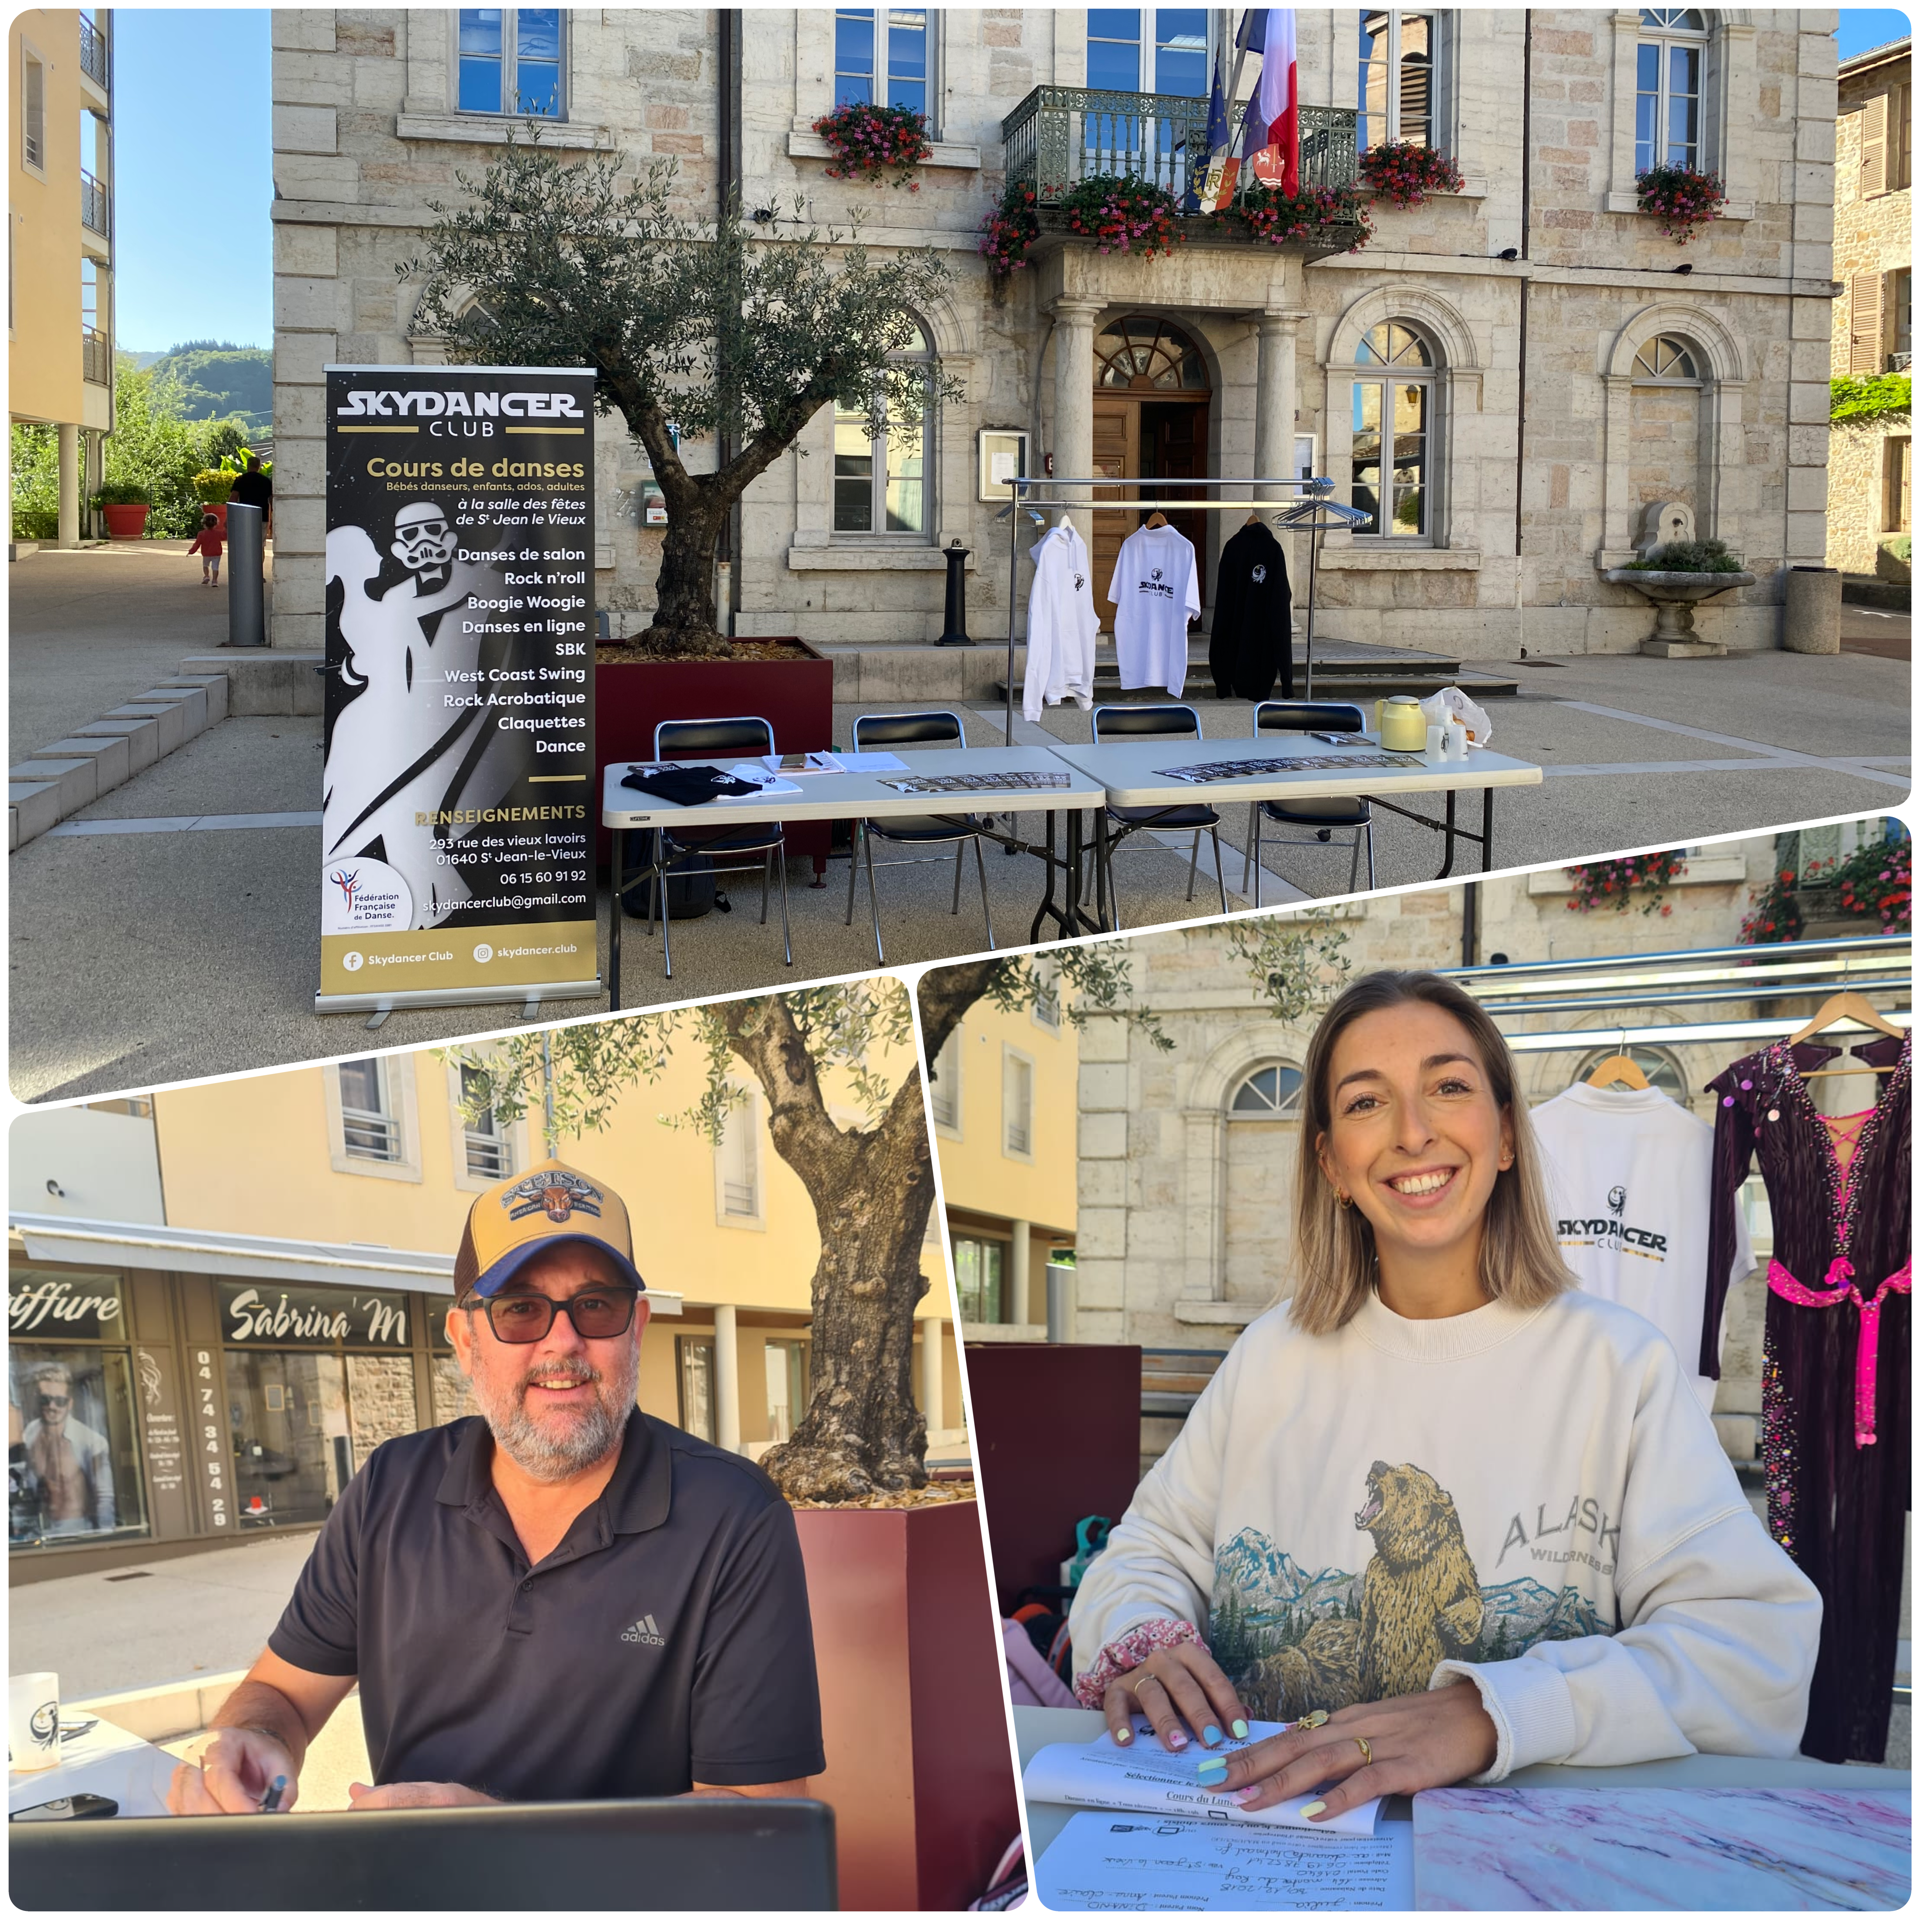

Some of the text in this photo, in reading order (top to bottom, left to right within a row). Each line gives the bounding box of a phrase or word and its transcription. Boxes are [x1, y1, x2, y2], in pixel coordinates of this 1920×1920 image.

[337, 391, 584, 418] SKYDANCER
[429, 421, 494, 437] CLUB
[366, 457, 585, 478] Cours de danses
[386, 482, 585, 492] Bébés danseurs, enfants, ados, adultes
[458, 498, 586, 510] à la salle des fêtes
[455, 514, 475, 525] de
[493, 514, 528, 525] Jean
[531, 514, 545, 525] le
[548, 514, 586, 525] Vieux
[458, 548, 586, 561] Danses de salon
[504, 572, 544, 585] Rock
[467, 595, 586, 613] Boogie Woogie
[462, 619, 586, 636] Danses en ligne
[555, 643, 586, 656] SBK
[444, 667, 586, 683] West Coast Swing
[443, 691, 586, 708] Rock Acrobatique
[498, 716, 586, 732] Claquettes
[536, 740, 586, 753] Dance
[414, 805, 586, 826] RENSEIGNEMENTS
[429, 832, 586, 850] 293 rue des vieux lavoirs
[436, 853, 478, 866] 01640
[494, 849, 587, 863] Jean-le-Vieux
[500, 870, 587, 885] 06 15 60 91 92
[354, 893, 399, 902] Fédération
[422, 893, 587, 914] skydancerclub@gmail.com
[354, 902, 396, 912] Française
[368, 951, 453, 967] Skydancer Club
[497, 943, 578, 959] skydancer.club
[1597, 1237, 1622, 1252] CLU
[1494, 1495, 1621, 1570] ALASK
[620, 1631, 665, 1646] adidas
[1124, 1771, 1184, 1785] Sélectionner
[1166, 1791, 1194, 1801] Cours
[1196, 1793, 1209, 1803] du
